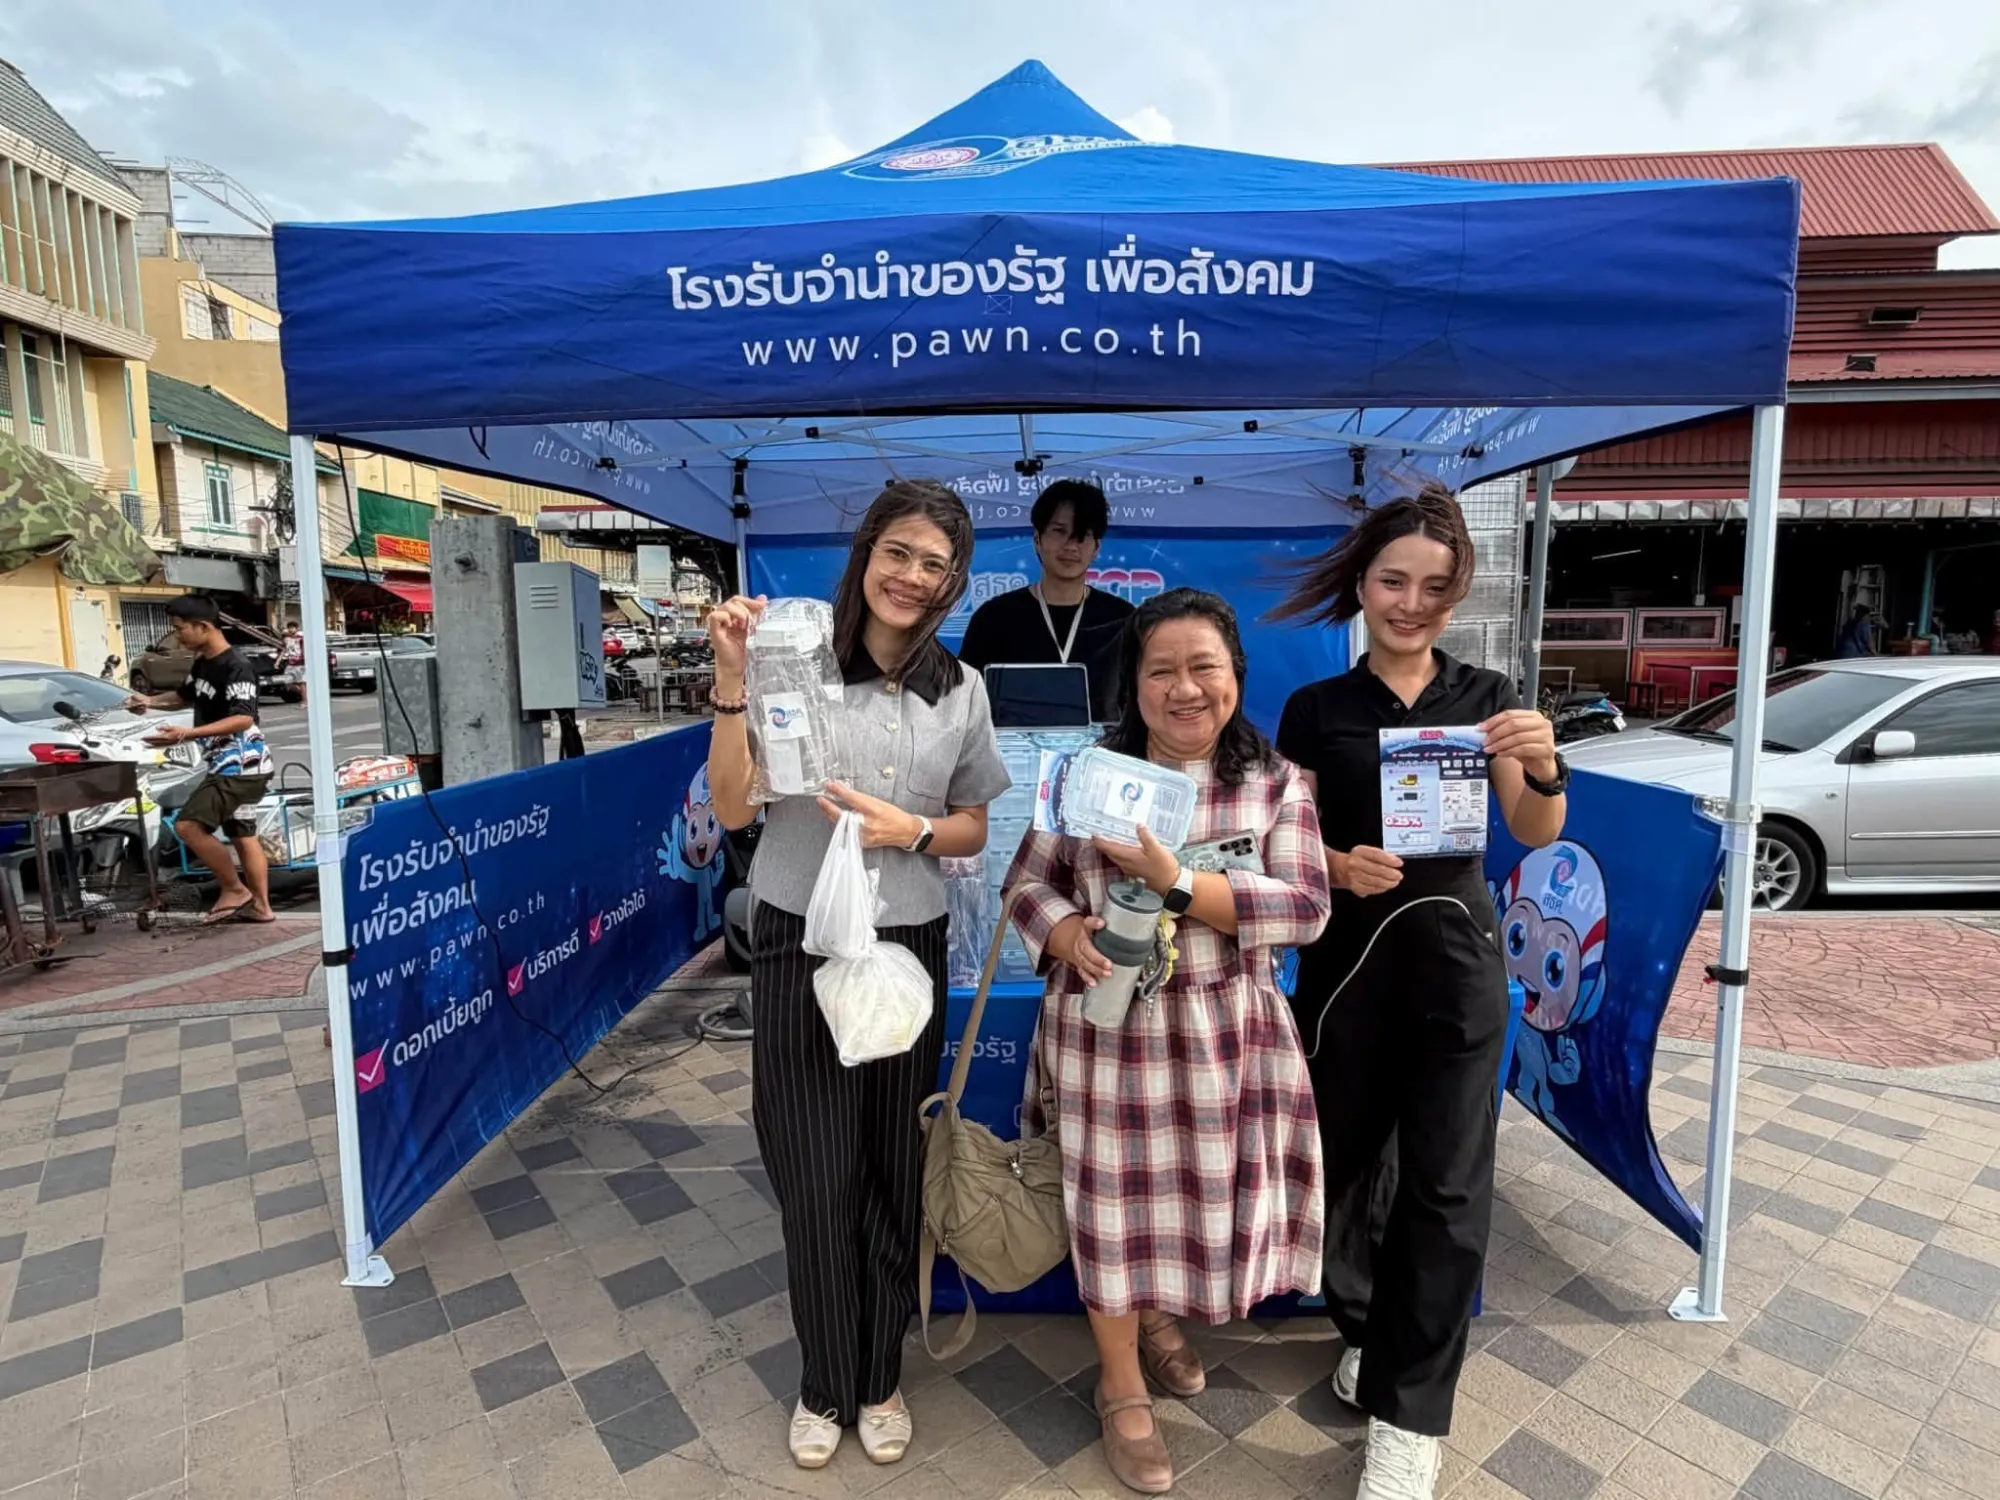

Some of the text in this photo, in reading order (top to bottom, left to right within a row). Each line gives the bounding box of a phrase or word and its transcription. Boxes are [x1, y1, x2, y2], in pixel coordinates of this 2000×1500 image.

[667, 233, 1315, 306] โรงรับจำนำของรัฐ เพื่อสังคม
[742, 318, 1202, 367] www.pawn.co.th
[359, 803, 550, 892] โรงรับจำนำของรัฐ
[352, 880, 477, 949] เพื่อสังคม
[603, 888, 646, 932] วางใจได้
[527, 928, 580, 980] บริการดี
[393, 988, 493, 1067] ดอกเบี้ยถูก
